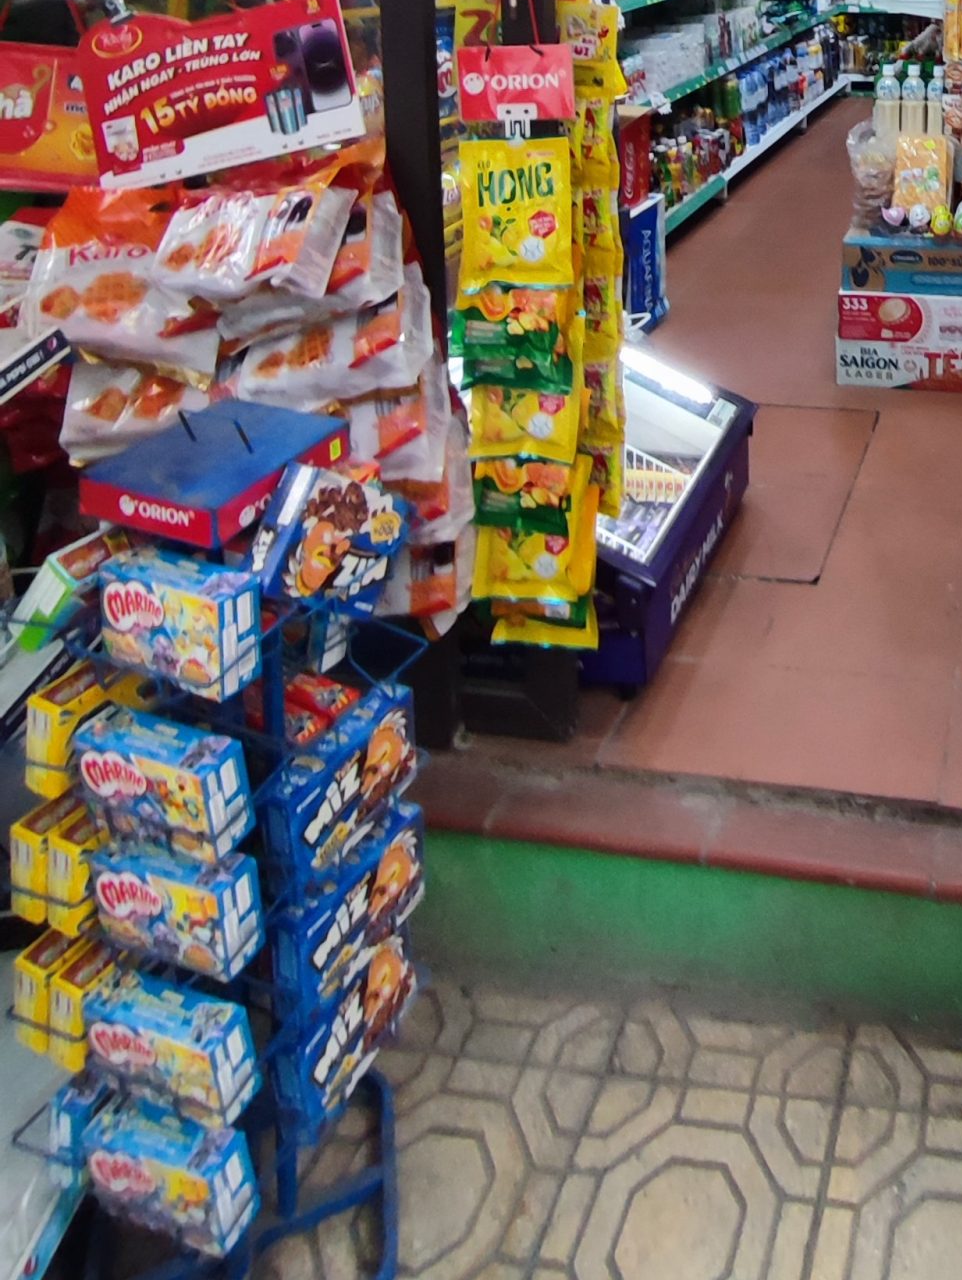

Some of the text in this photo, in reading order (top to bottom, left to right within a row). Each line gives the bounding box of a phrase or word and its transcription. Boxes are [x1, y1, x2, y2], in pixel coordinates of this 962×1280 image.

[107, 53, 161, 91] KARO
[165, 35, 209, 63] LIỀN
[212, 32, 248, 51] TAY
[141, 66, 175, 93] NGAY
[490, 72, 561, 91] ORION
[140, 96, 176, 135] 15
[842, 297, 868, 310] 333
[840, 355, 899, 371] SAIGON
[845, 370, 894, 381] LAGER
[139, 502, 192, 525] ORION
